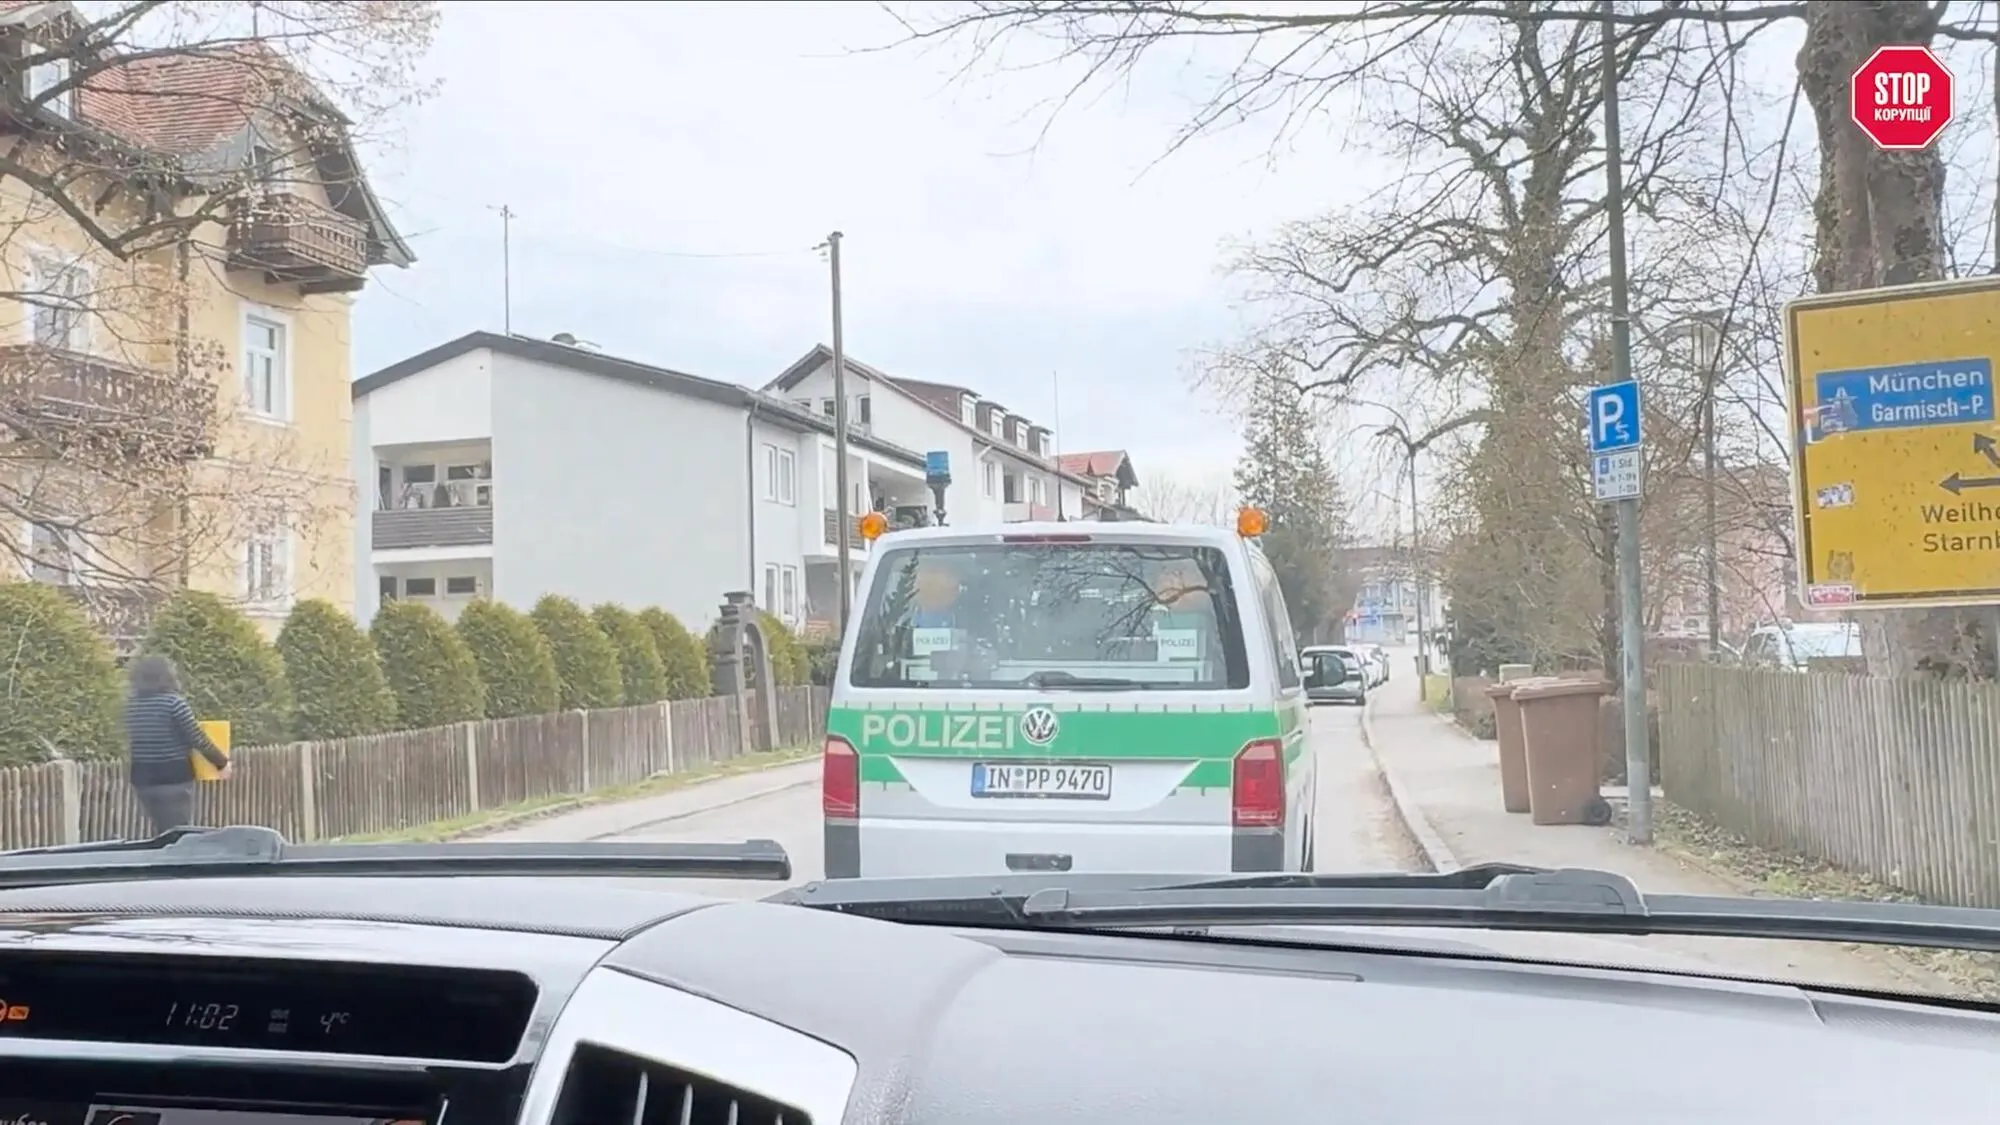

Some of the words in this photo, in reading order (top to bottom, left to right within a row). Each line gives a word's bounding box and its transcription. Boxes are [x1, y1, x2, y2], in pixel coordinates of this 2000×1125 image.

[1868, 370, 1984, 395] München
[1598, 394, 1624, 442] P
[1871, 395, 1984, 423] Garmisch-P
[1161, 637, 1196, 648] POLIZEI
[862, 714, 1014, 749] POLIZEI
[989, 768, 1012, 788] IN
[1025, 769, 1050, 790] PP
[1055, 769, 1104, 791] 9470
[166, 1002, 239, 1030] 11:02
